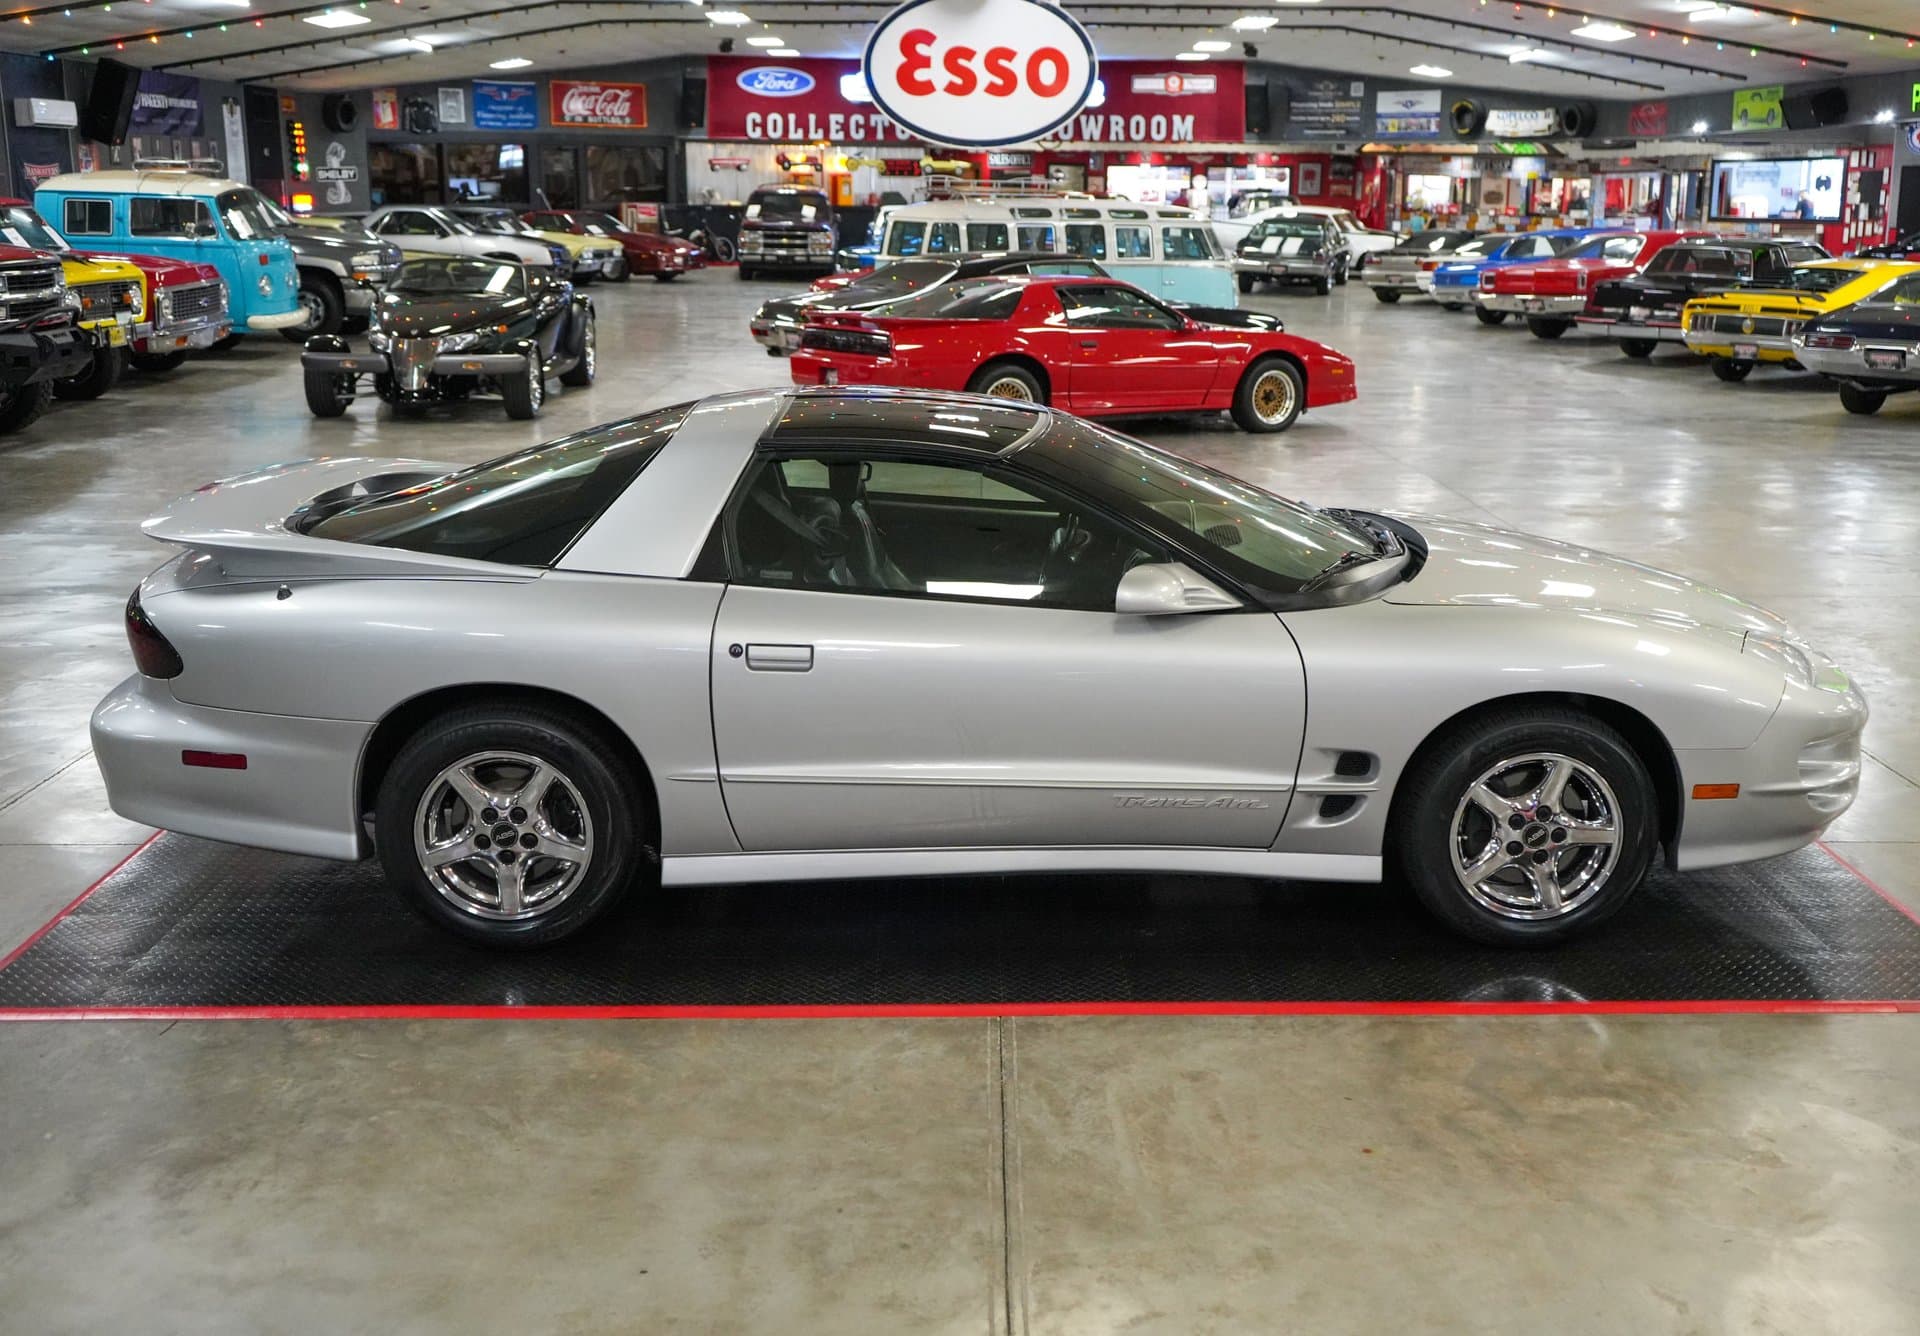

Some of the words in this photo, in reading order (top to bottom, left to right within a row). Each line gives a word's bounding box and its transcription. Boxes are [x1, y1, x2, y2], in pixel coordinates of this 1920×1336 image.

[754, 72, 798, 90] Ford
[746, 112, 914, 140] COLLECTO
[1046, 114, 1195, 142] OWROOM
[318, 169, 356, 180] SHELBY
